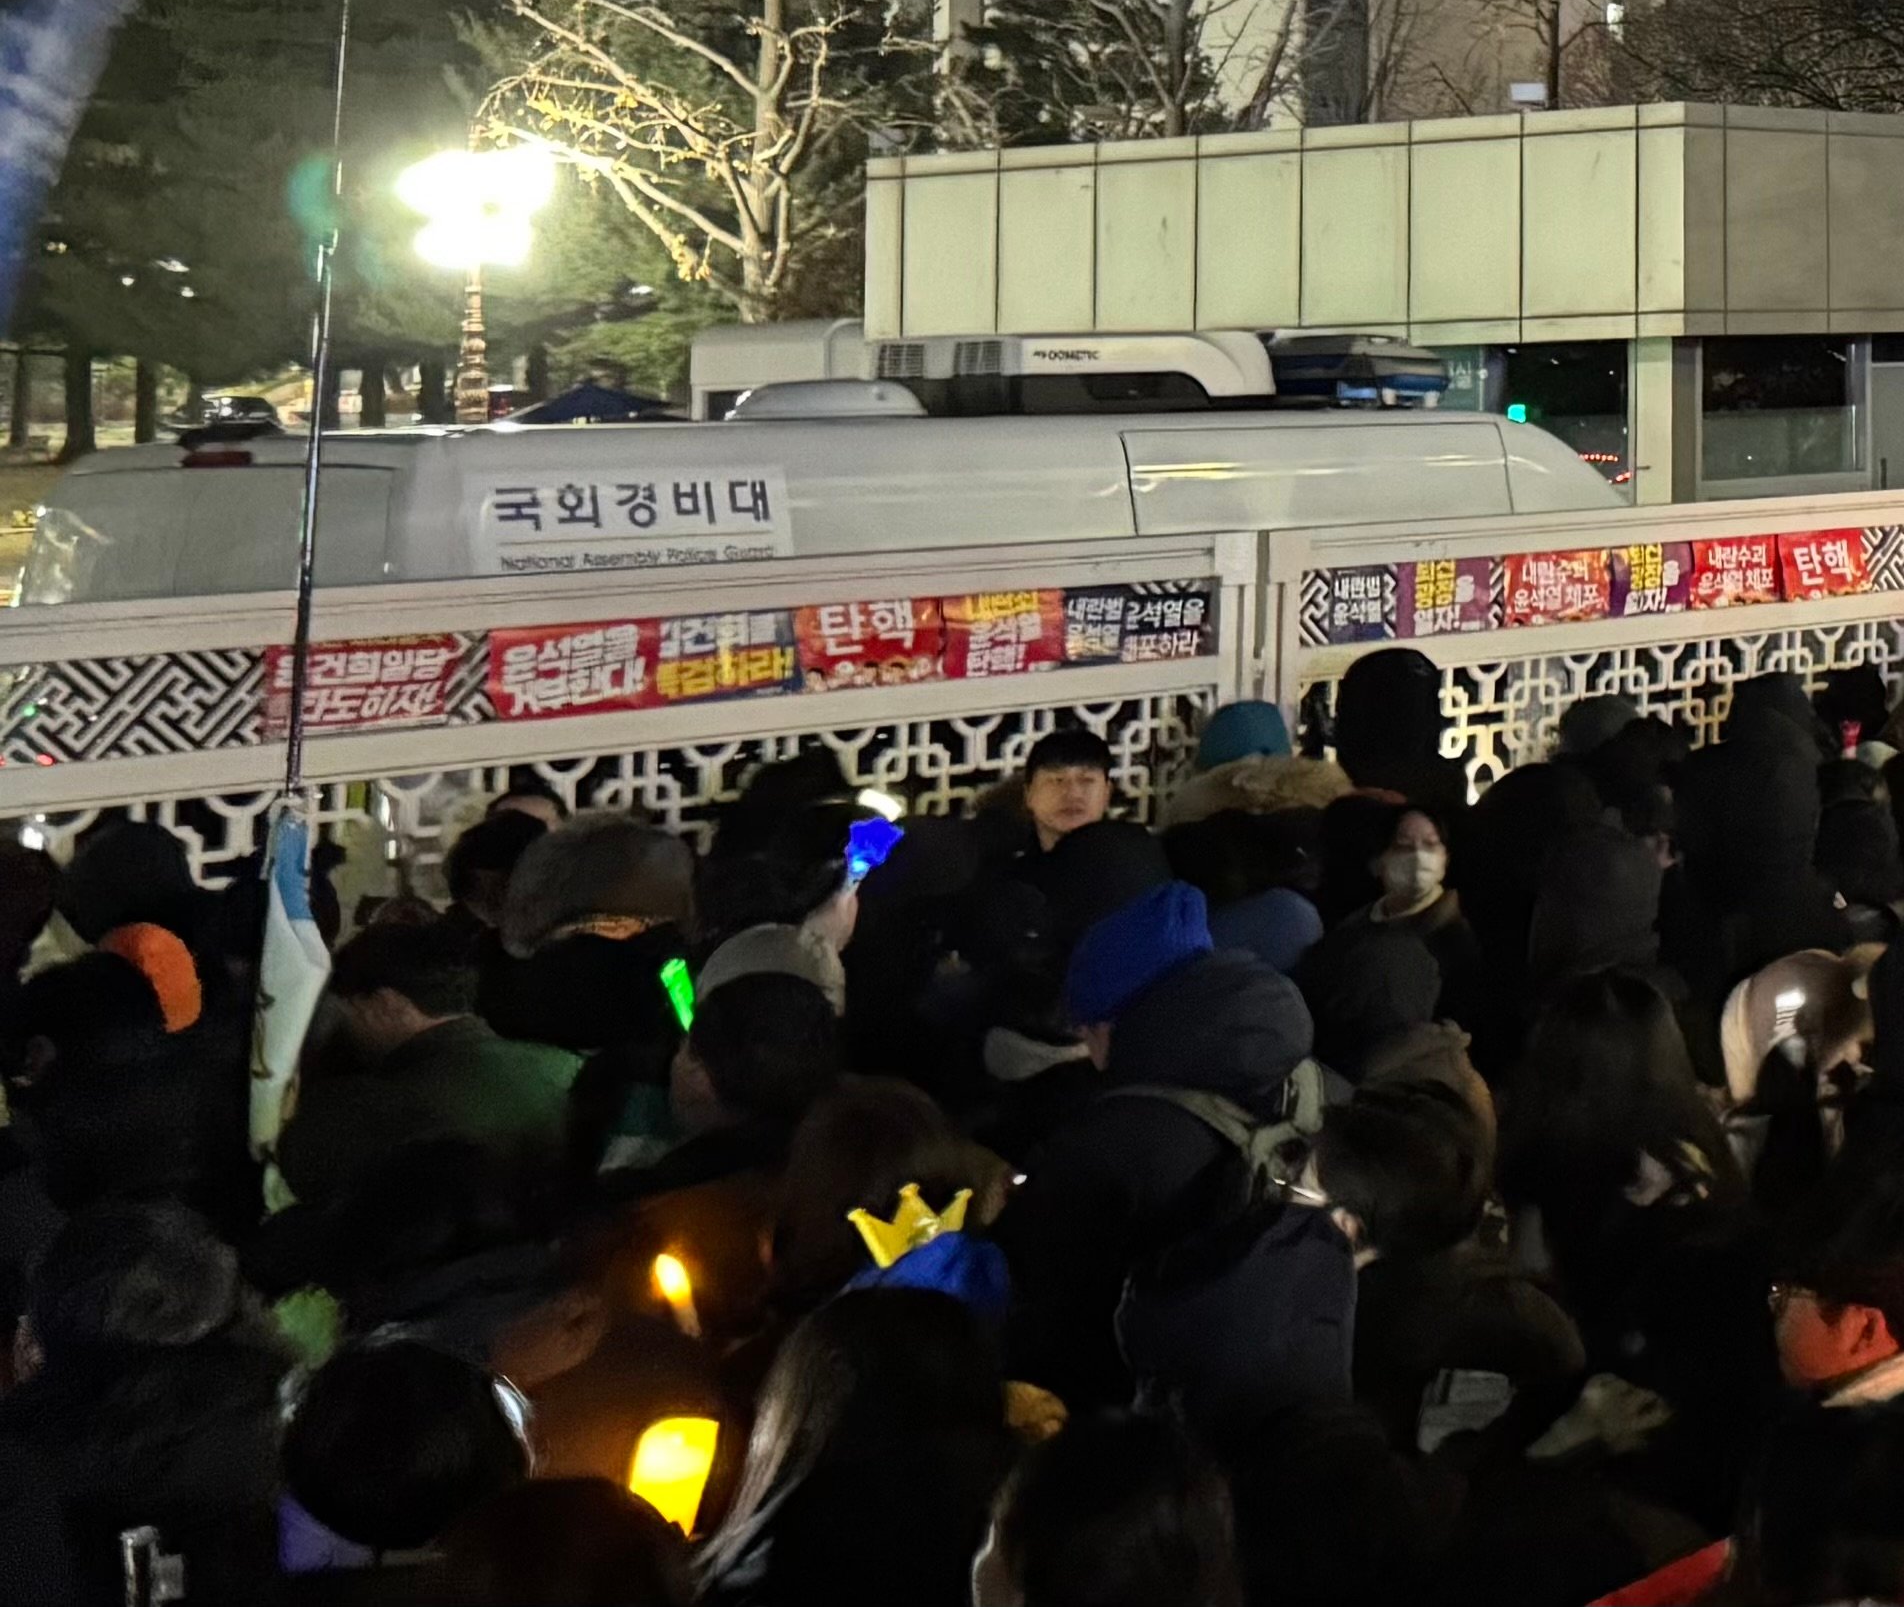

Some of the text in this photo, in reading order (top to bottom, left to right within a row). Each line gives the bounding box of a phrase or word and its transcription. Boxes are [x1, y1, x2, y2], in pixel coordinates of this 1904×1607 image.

[494, 480, 770, 531] 국회경비대
[1708, 545, 1767, 570] 내란수괴
[1793, 539, 1853, 586] 탄핵
[1514, 586, 1563, 613] 윤석열
[1699, 569, 1776, 594] 윤석열 체포
[819, 600, 915, 656] 탄핵
[968, 612, 1042, 651] 윤석열
[1333, 599, 1382, 626] 윤석열
[502, 623, 640, 686] 윤석열을
[502, 657, 647, 716] 거부한다!
